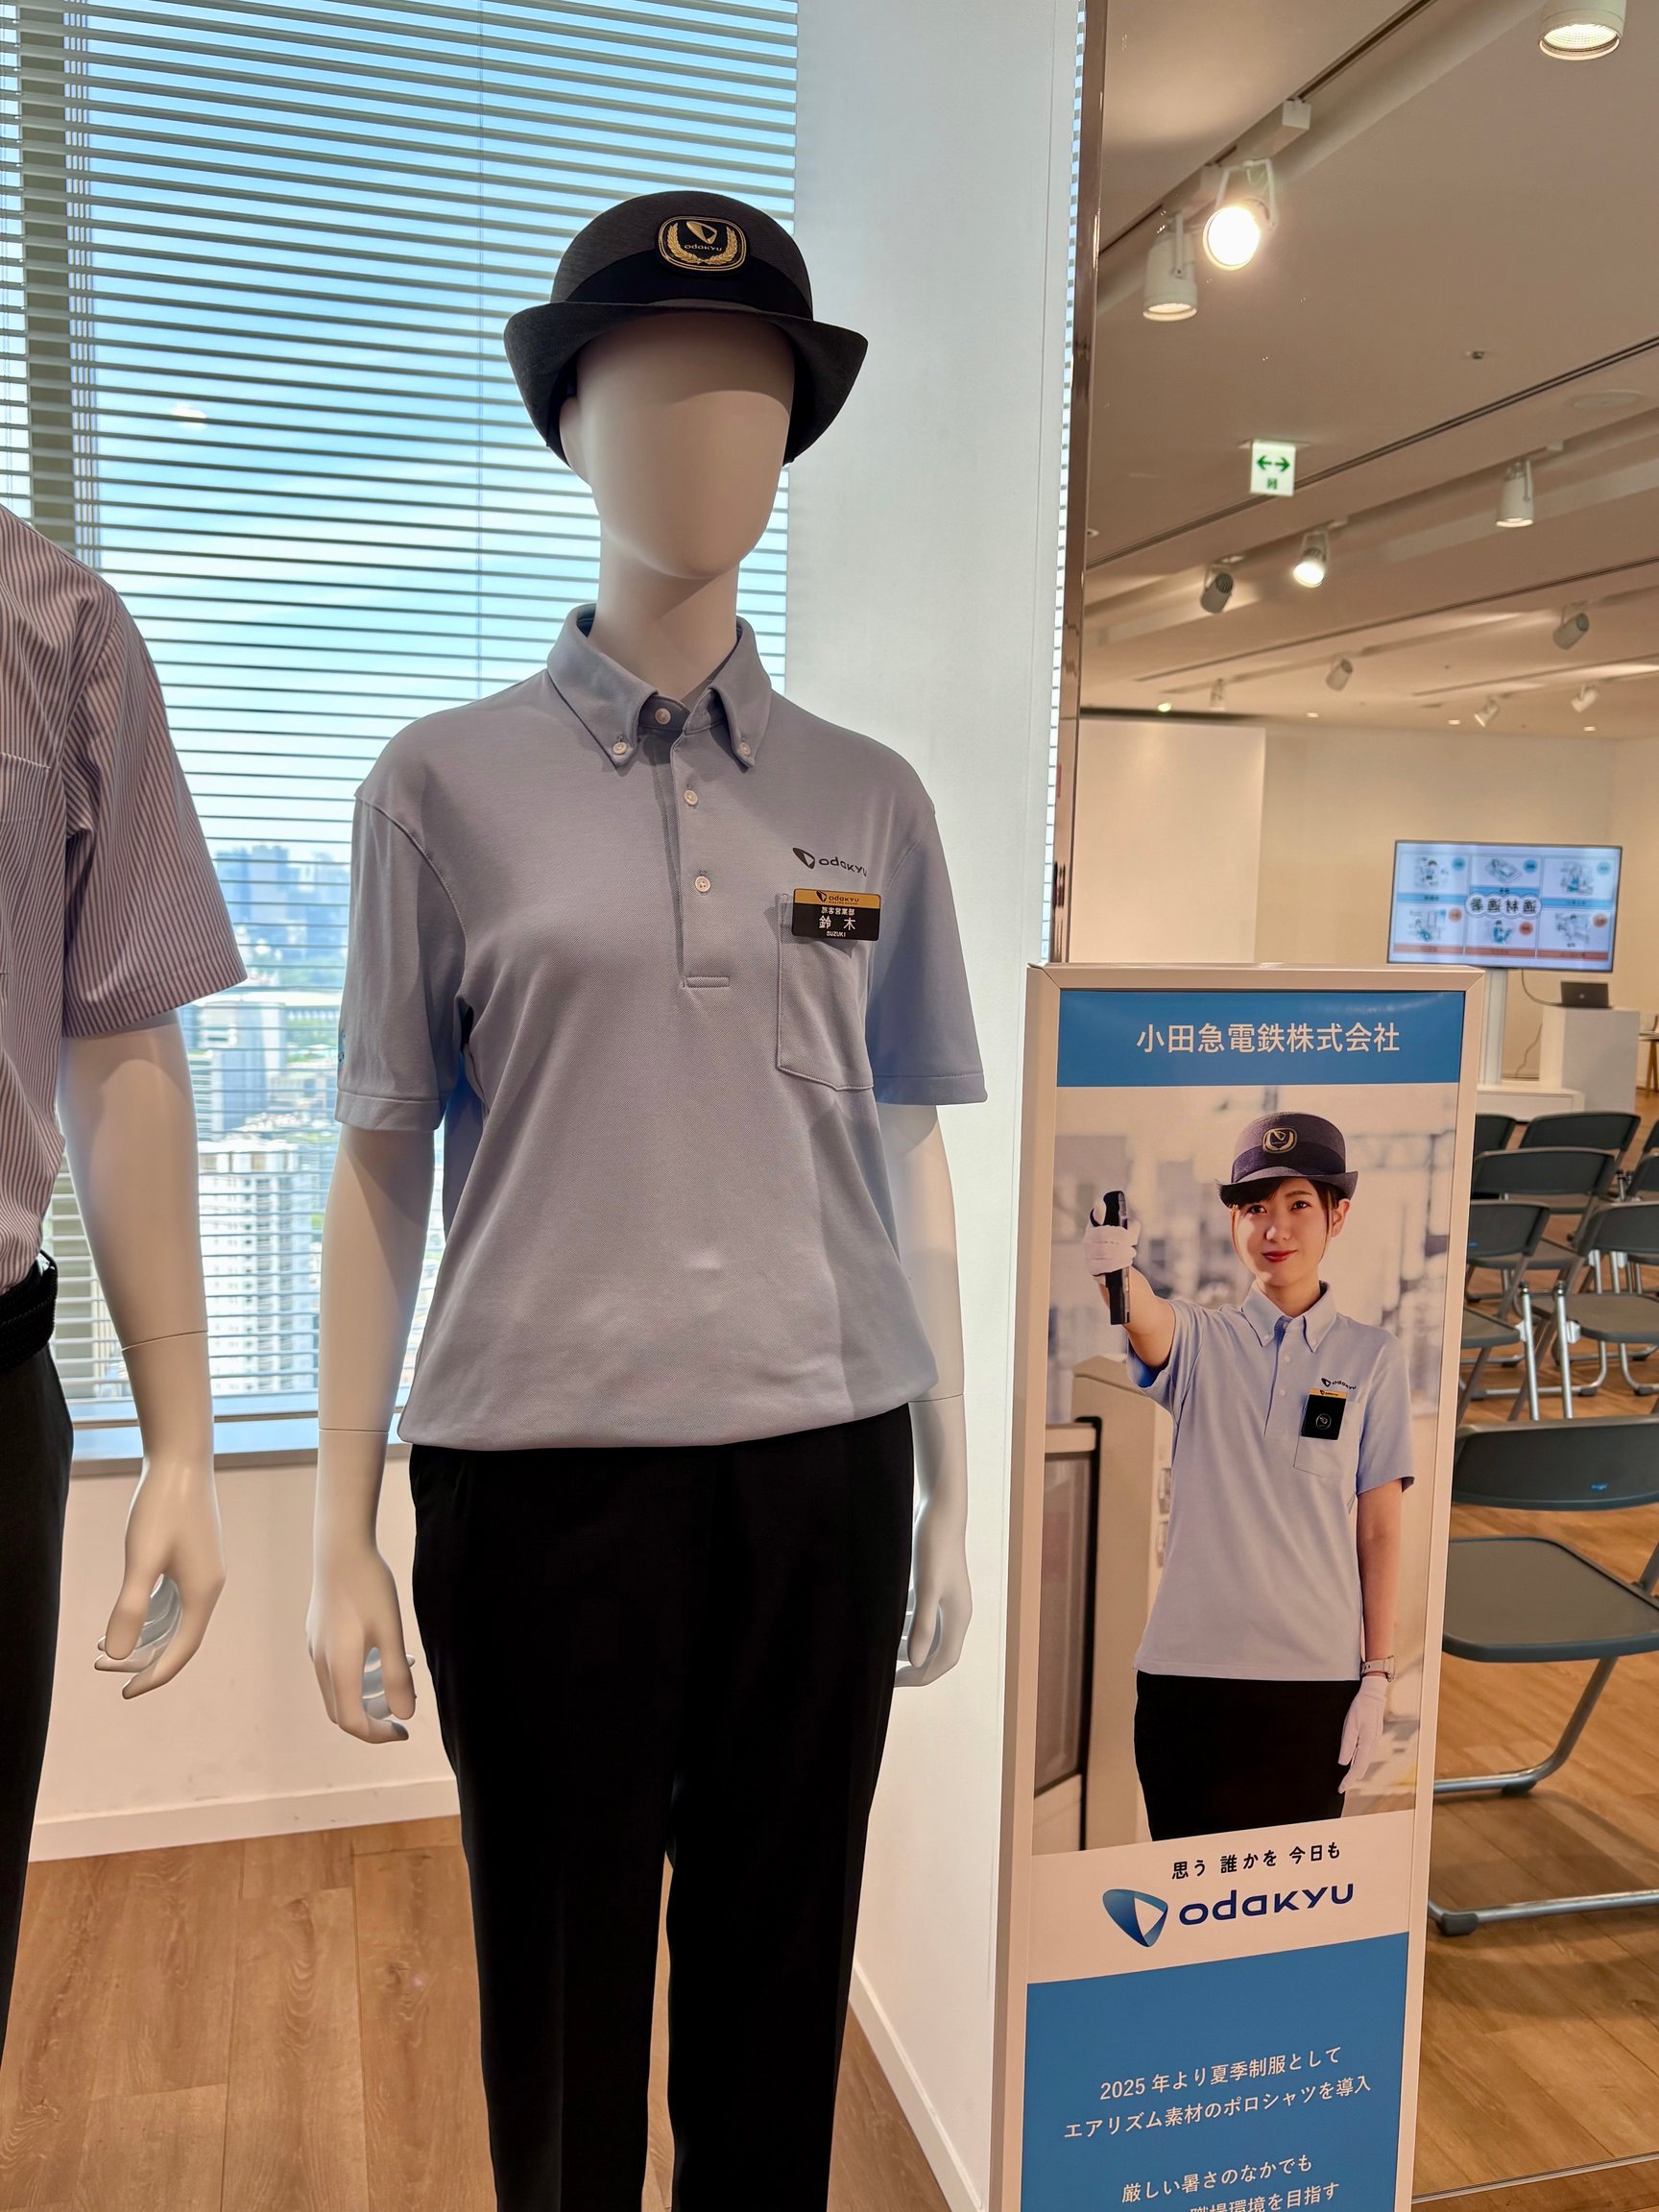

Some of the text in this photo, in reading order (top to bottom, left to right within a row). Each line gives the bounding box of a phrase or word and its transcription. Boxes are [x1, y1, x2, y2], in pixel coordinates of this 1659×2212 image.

[819, 856, 868, 878] odakyu
[1137, 1022, 1400, 1053] 小田急電鉄株式会社
[1172, 1842, 1340, 1879] 思う 誰かを 今日も
[1179, 1884, 1354, 1926] odakyu
[1064, 2075, 1371, 2139] エアリズム素材のポロシャツを導入
[1121, 2154, 1312, 2203] 厳しい暑さのなかでも
